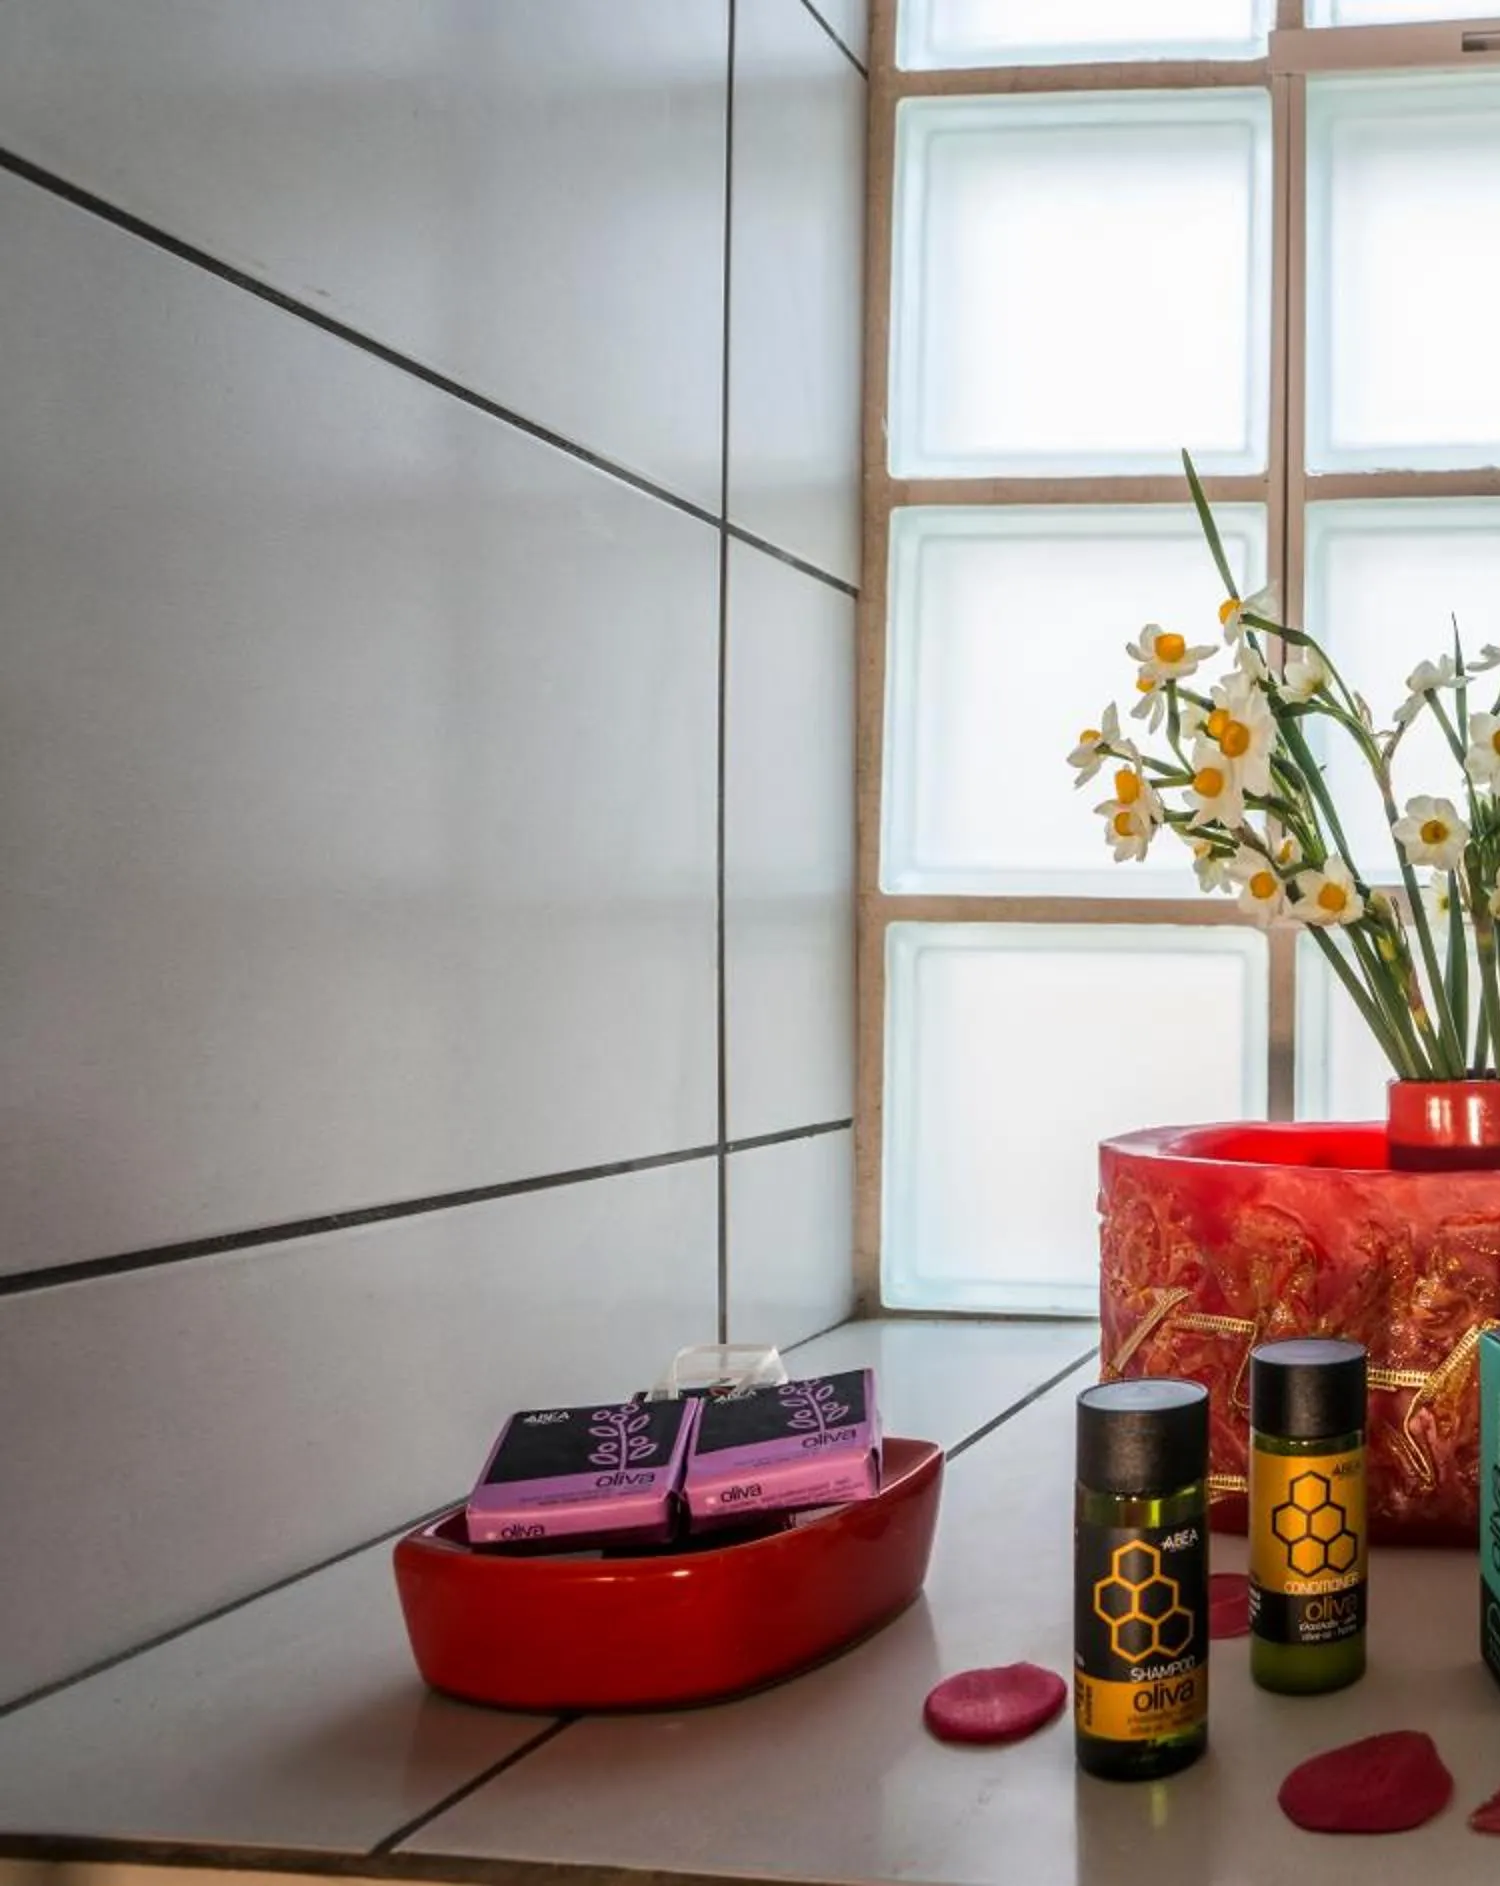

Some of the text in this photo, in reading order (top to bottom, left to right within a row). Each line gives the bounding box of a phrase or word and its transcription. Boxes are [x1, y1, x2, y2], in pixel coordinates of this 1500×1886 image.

[801, 1429, 857, 1449] oliva
[596, 1471, 655, 1488] oliva
[720, 1483, 762, 1503] oliva
[501, 1523, 545, 1539] oliva
[1161, 1528, 1198, 1551] ABEA
[1283, 1571, 1359, 1595] CONDITIONER
[1305, 1593, 1357, 1621] oliva
[1130, 1655, 1195, 1683] SHAMPOO
[1133, 1679, 1194, 1713] oliva
